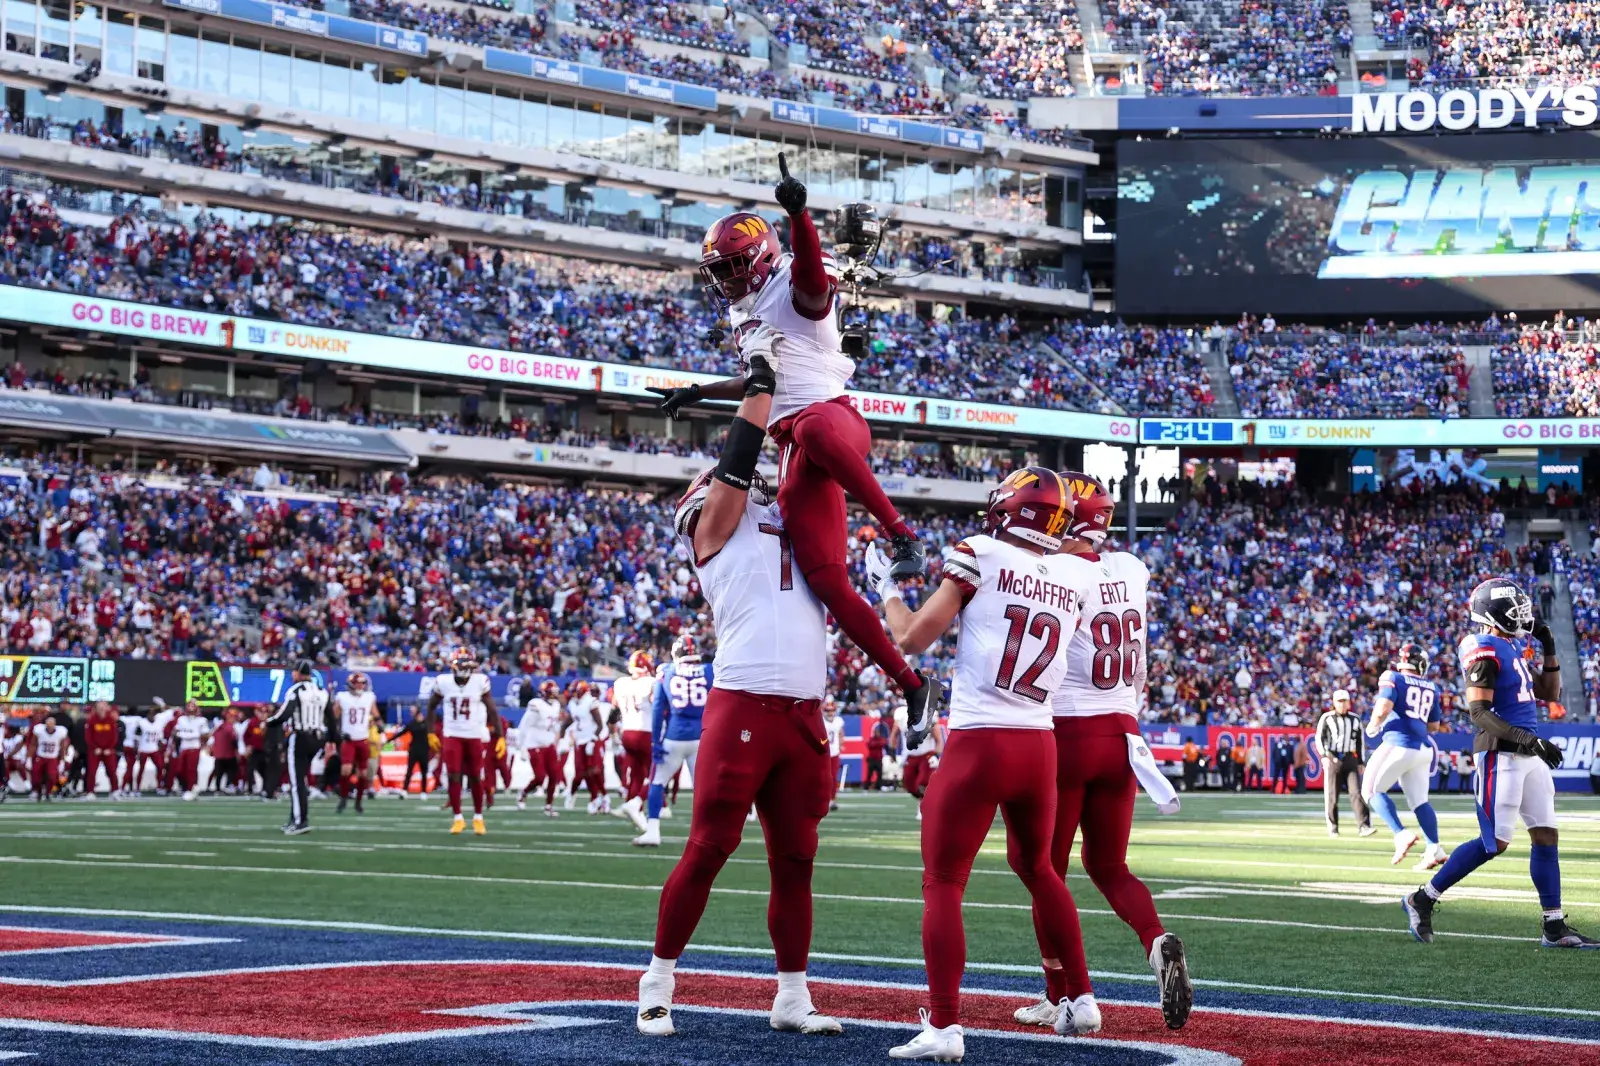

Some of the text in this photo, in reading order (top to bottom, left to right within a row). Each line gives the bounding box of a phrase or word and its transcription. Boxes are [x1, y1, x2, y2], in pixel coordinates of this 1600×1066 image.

[1352, 85, 1598, 132] MOODY'S
[72, 302, 103, 322] GO
[110, 307, 145, 328] BIG
[151, 313, 208, 336] BREW
[468, 353, 494, 371] GO
[499, 357, 527, 375] BIG
[533, 362, 580, 381] BREW
[863, 399, 906, 415] BREW
[1110, 422, 1131, 437] GO
[1160, 422, 1213, 441] 2:14
[1306, 426, 1375, 439] DUNKIN'
[1502, 424, 1533, 438] GO
[1539, 424, 1573, 438] BIG
[551, 450, 589, 463] MetLife
[997, 568, 1080, 615] McCAFFREY
[1098, 580, 1130, 605] ERTZ
[994, 604, 1061, 703] 12
[1090, 609, 1142, 690] 86
[27, 664, 82, 693] 0:06
[270, 669, 285, 702] 7
[670, 675, 708, 708] 96
[349, 707, 366, 725] 87
[450, 697, 471, 720] 14
[1405, 685, 1435, 723] 98
